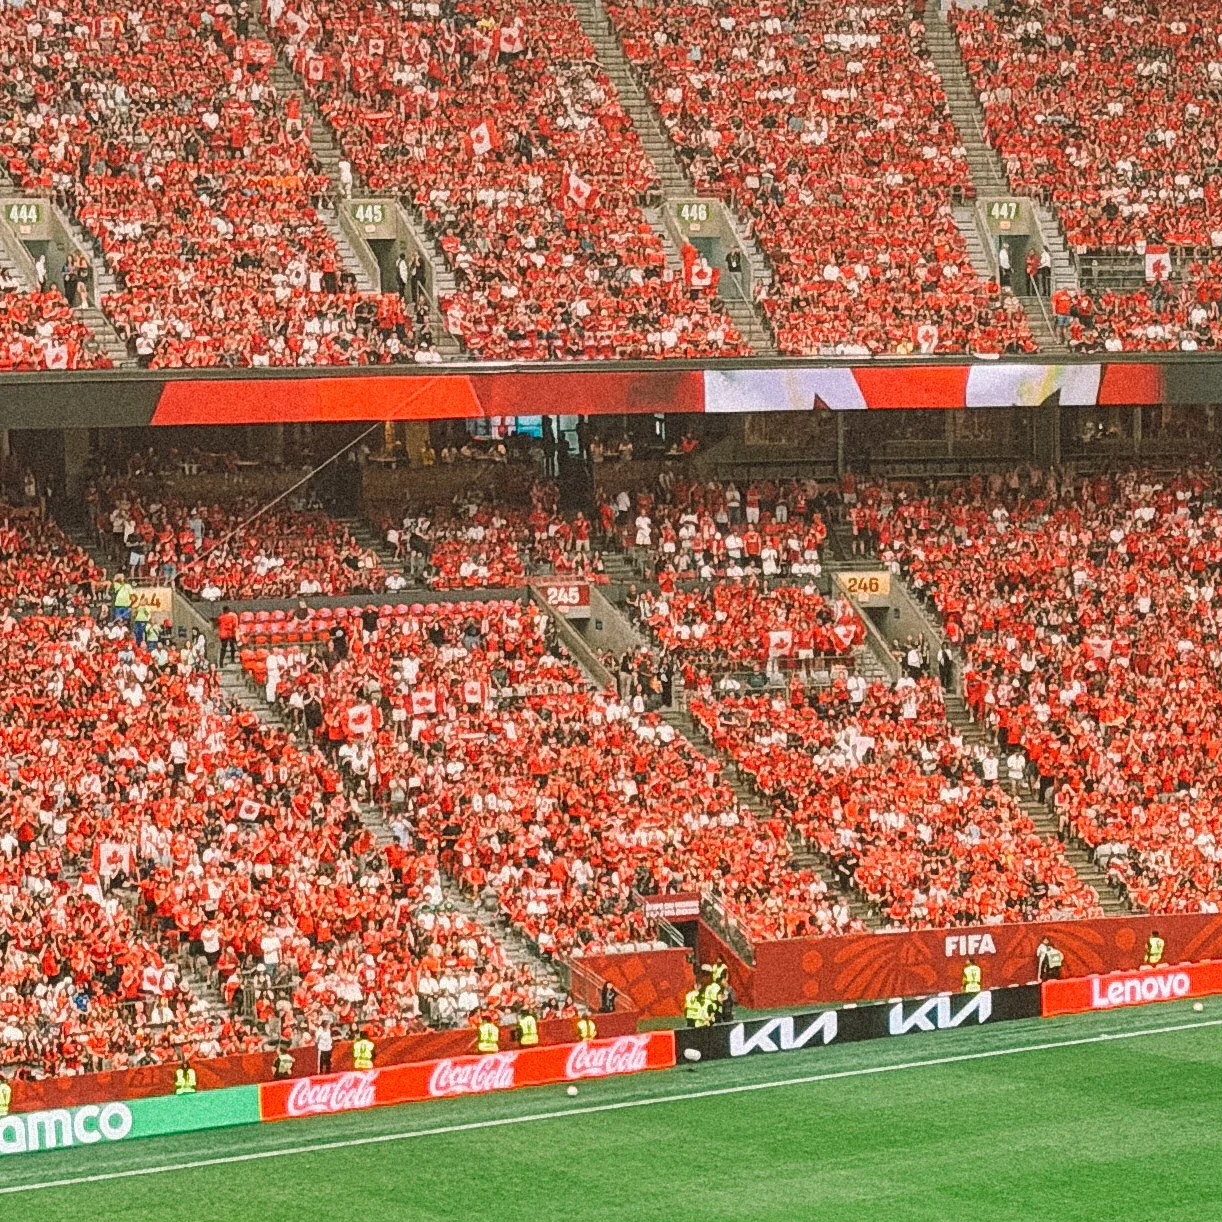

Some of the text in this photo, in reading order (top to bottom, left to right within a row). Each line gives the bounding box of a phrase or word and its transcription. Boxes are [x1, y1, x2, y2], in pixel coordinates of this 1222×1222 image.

[10, 204, 37, 223] 444
[355, 204, 383, 222] 445
[991, 202, 1017, 219] 447
[547, 587, 580, 605] 245
[847, 577, 879, 594] 246
[945, 933, 997, 957] FIFA
[1090, 972, 1190, 1007] Lenovo
[889, 990, 992, 1035] KIA
[730, 1010, 838, 1057] KIA
[0, 1102, 133, 1154] amco
